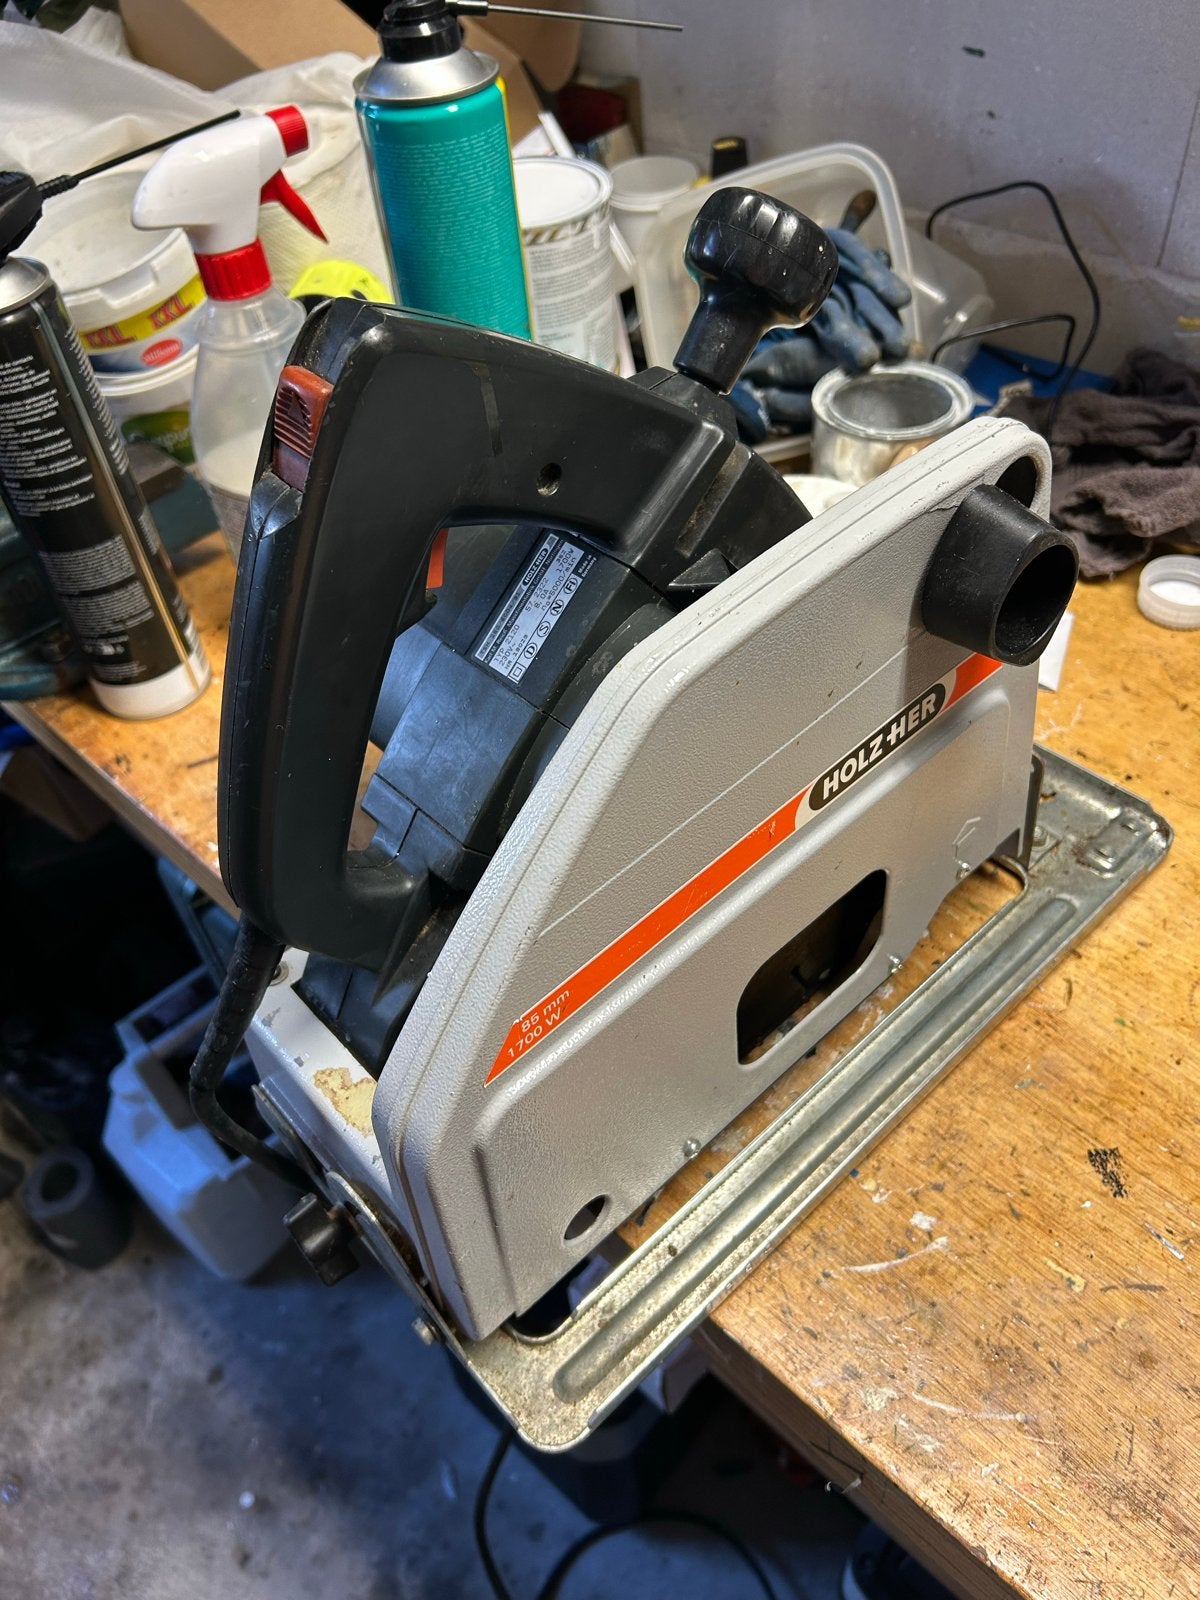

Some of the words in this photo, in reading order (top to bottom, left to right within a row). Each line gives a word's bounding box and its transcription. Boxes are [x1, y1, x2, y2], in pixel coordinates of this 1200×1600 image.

[84, 325, 136, 349] XXL
[149, 294, 193, 330] XXL
[555, 547, 575, 573] 1700W
[577, 559, 588, 573] Made
[493, 647, 505, 663] TYP
[504, 623, 520, 644] 2120
[525, 644, 536, 655] D
[538, 623, 549, 634] S
[551, 602, 562, 612] N
[521, 1013, 540, 1033] 85
[543, 990, 570, 1015] mm
[545, 1007, 561, 1026] W
